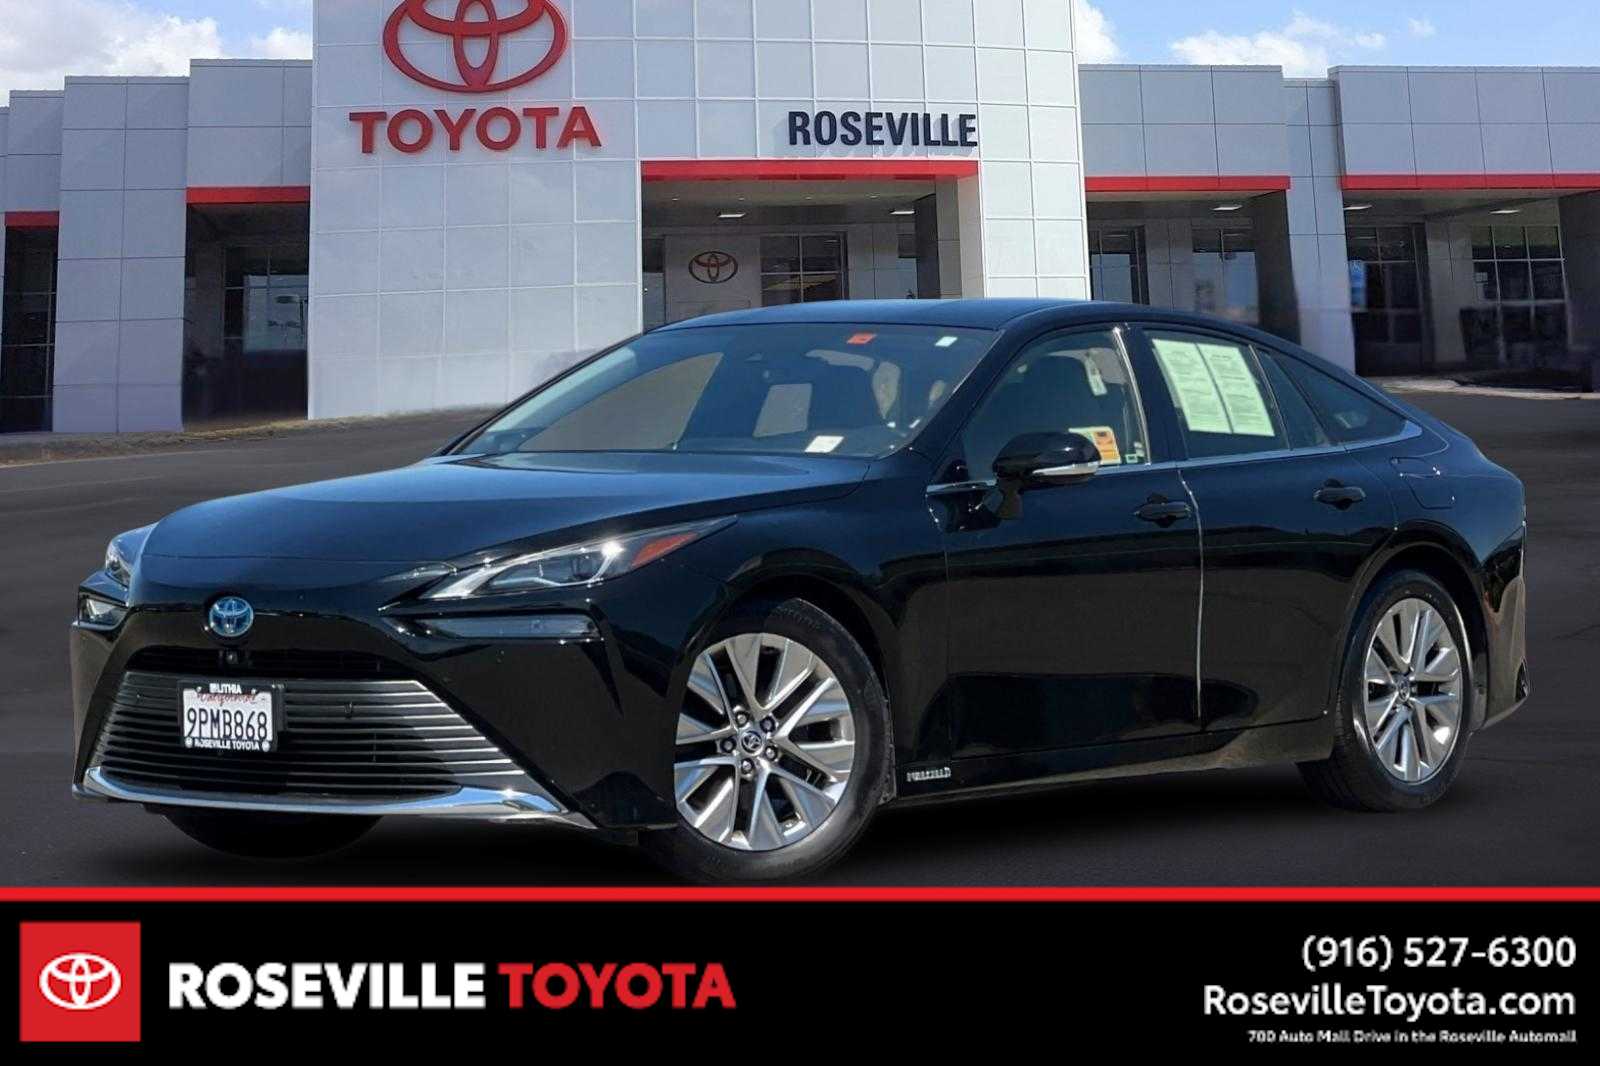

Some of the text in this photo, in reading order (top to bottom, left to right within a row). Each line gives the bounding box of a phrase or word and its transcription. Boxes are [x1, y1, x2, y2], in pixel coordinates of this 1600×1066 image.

[349, 106, 602, 154] TOYOTA
[788, 111, 978, 147] ROSEVILLE
[187, 708, 267, 740] 9PMB868
[232, 740, 260, 751] TOYOTA
